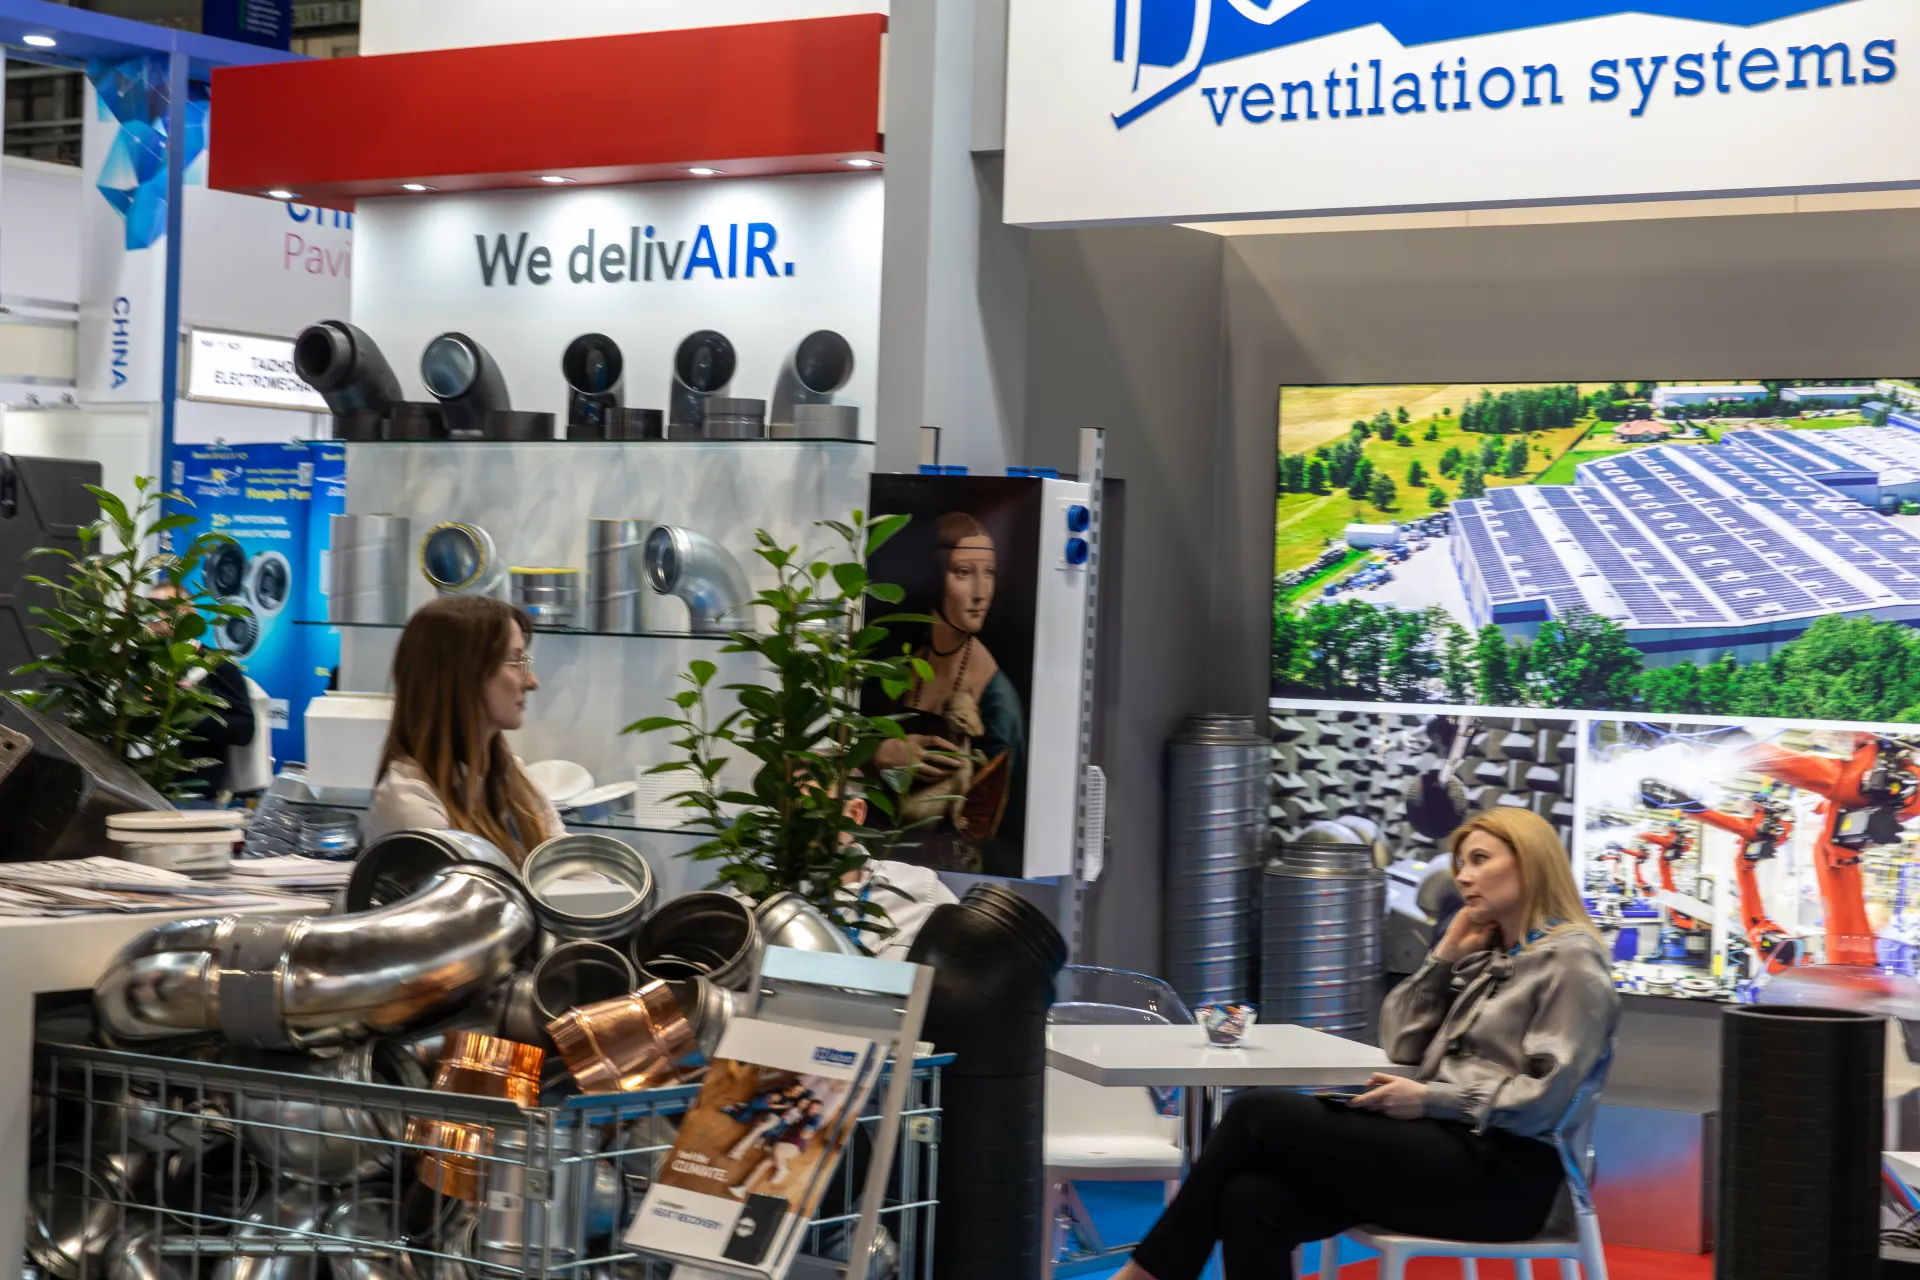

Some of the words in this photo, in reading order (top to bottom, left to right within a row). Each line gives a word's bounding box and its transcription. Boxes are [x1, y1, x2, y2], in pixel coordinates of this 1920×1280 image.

[1201, 57, 1564, 126] ventilation
[1589, 39, 1897, 117] systems
[284, 232, 353, 279] Pavi
[475, 231, 552, 286] We
[568, 222, 796, 284] delivAIR.
[110, 296, 130, 390] CHINA
